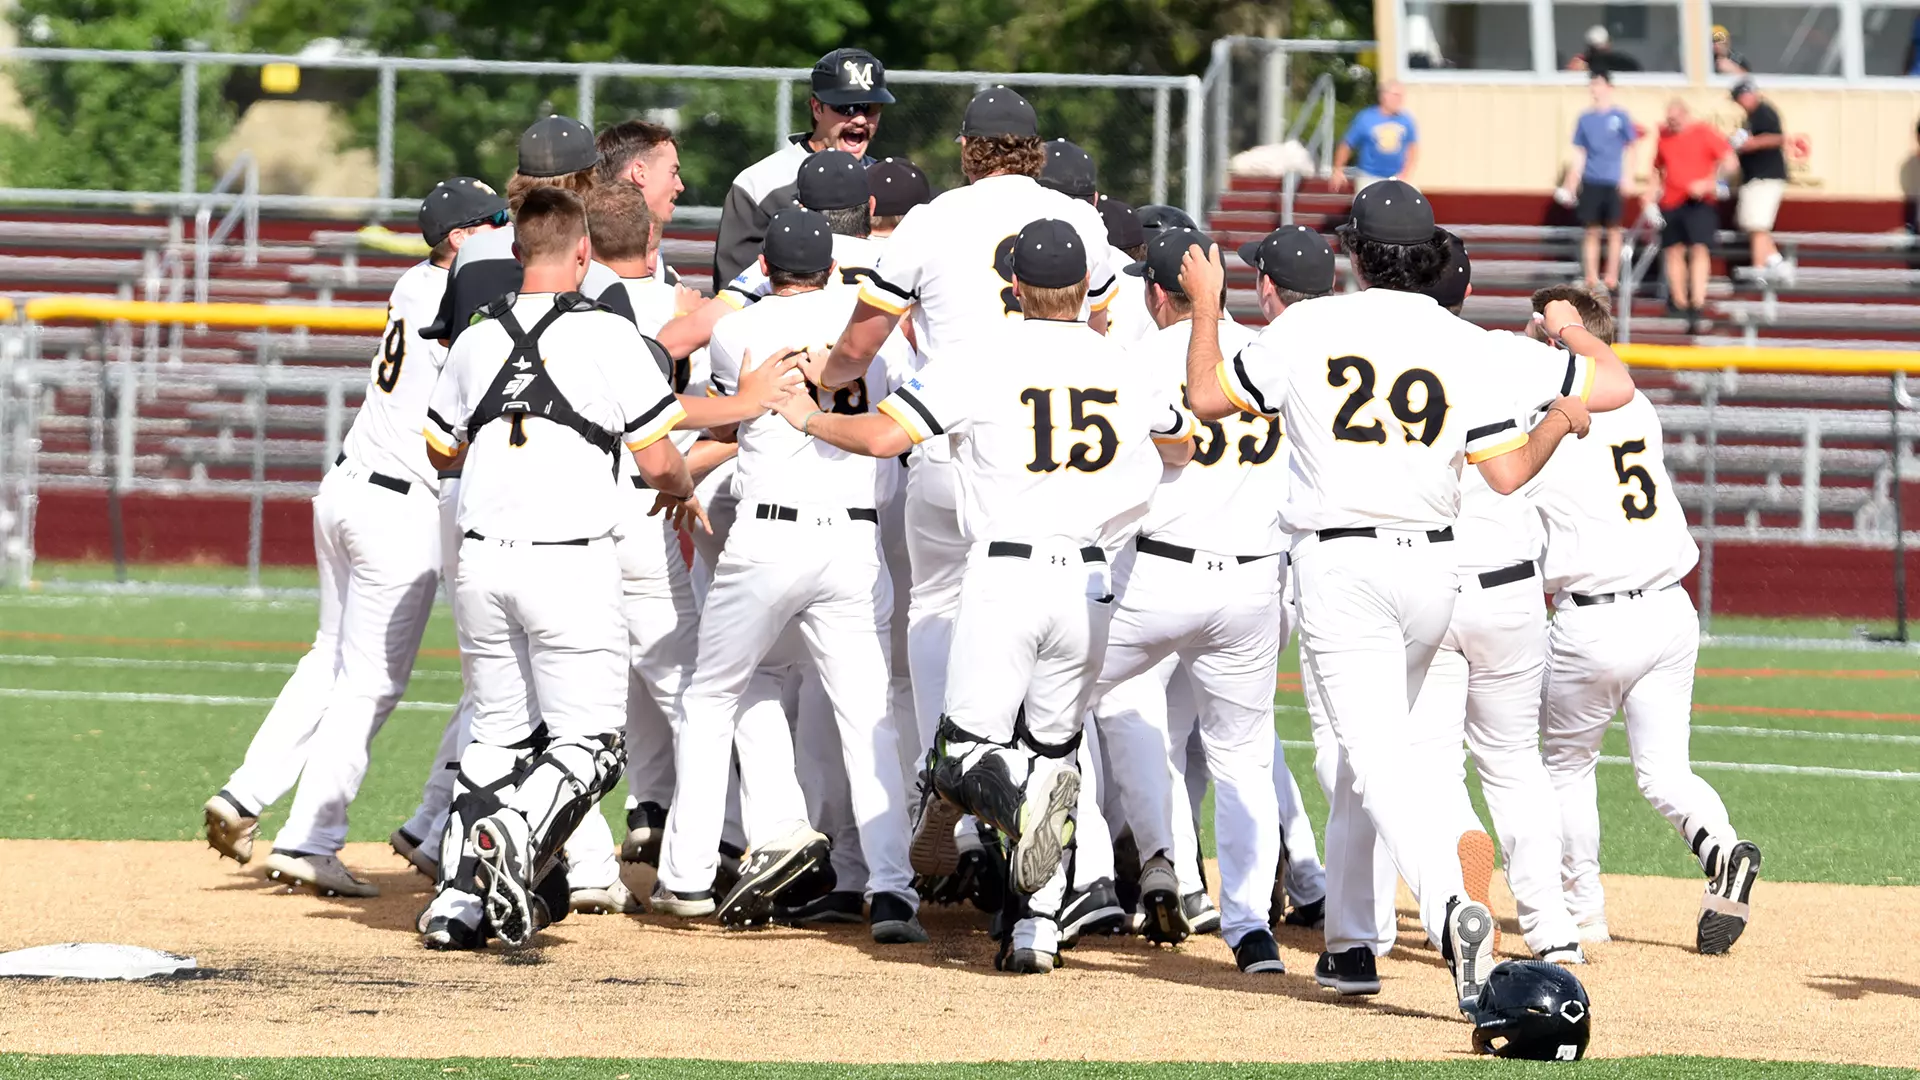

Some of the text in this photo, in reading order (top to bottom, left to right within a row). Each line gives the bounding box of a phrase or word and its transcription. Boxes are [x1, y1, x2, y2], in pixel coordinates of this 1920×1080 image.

[843, 60, 875, 91] M
[375, 301, 407, 394] 9
[1019, 386, 1123, 474] 15
[1326, 354, 1453, 448] 29
[1607, 437, 1658, 523] 5
